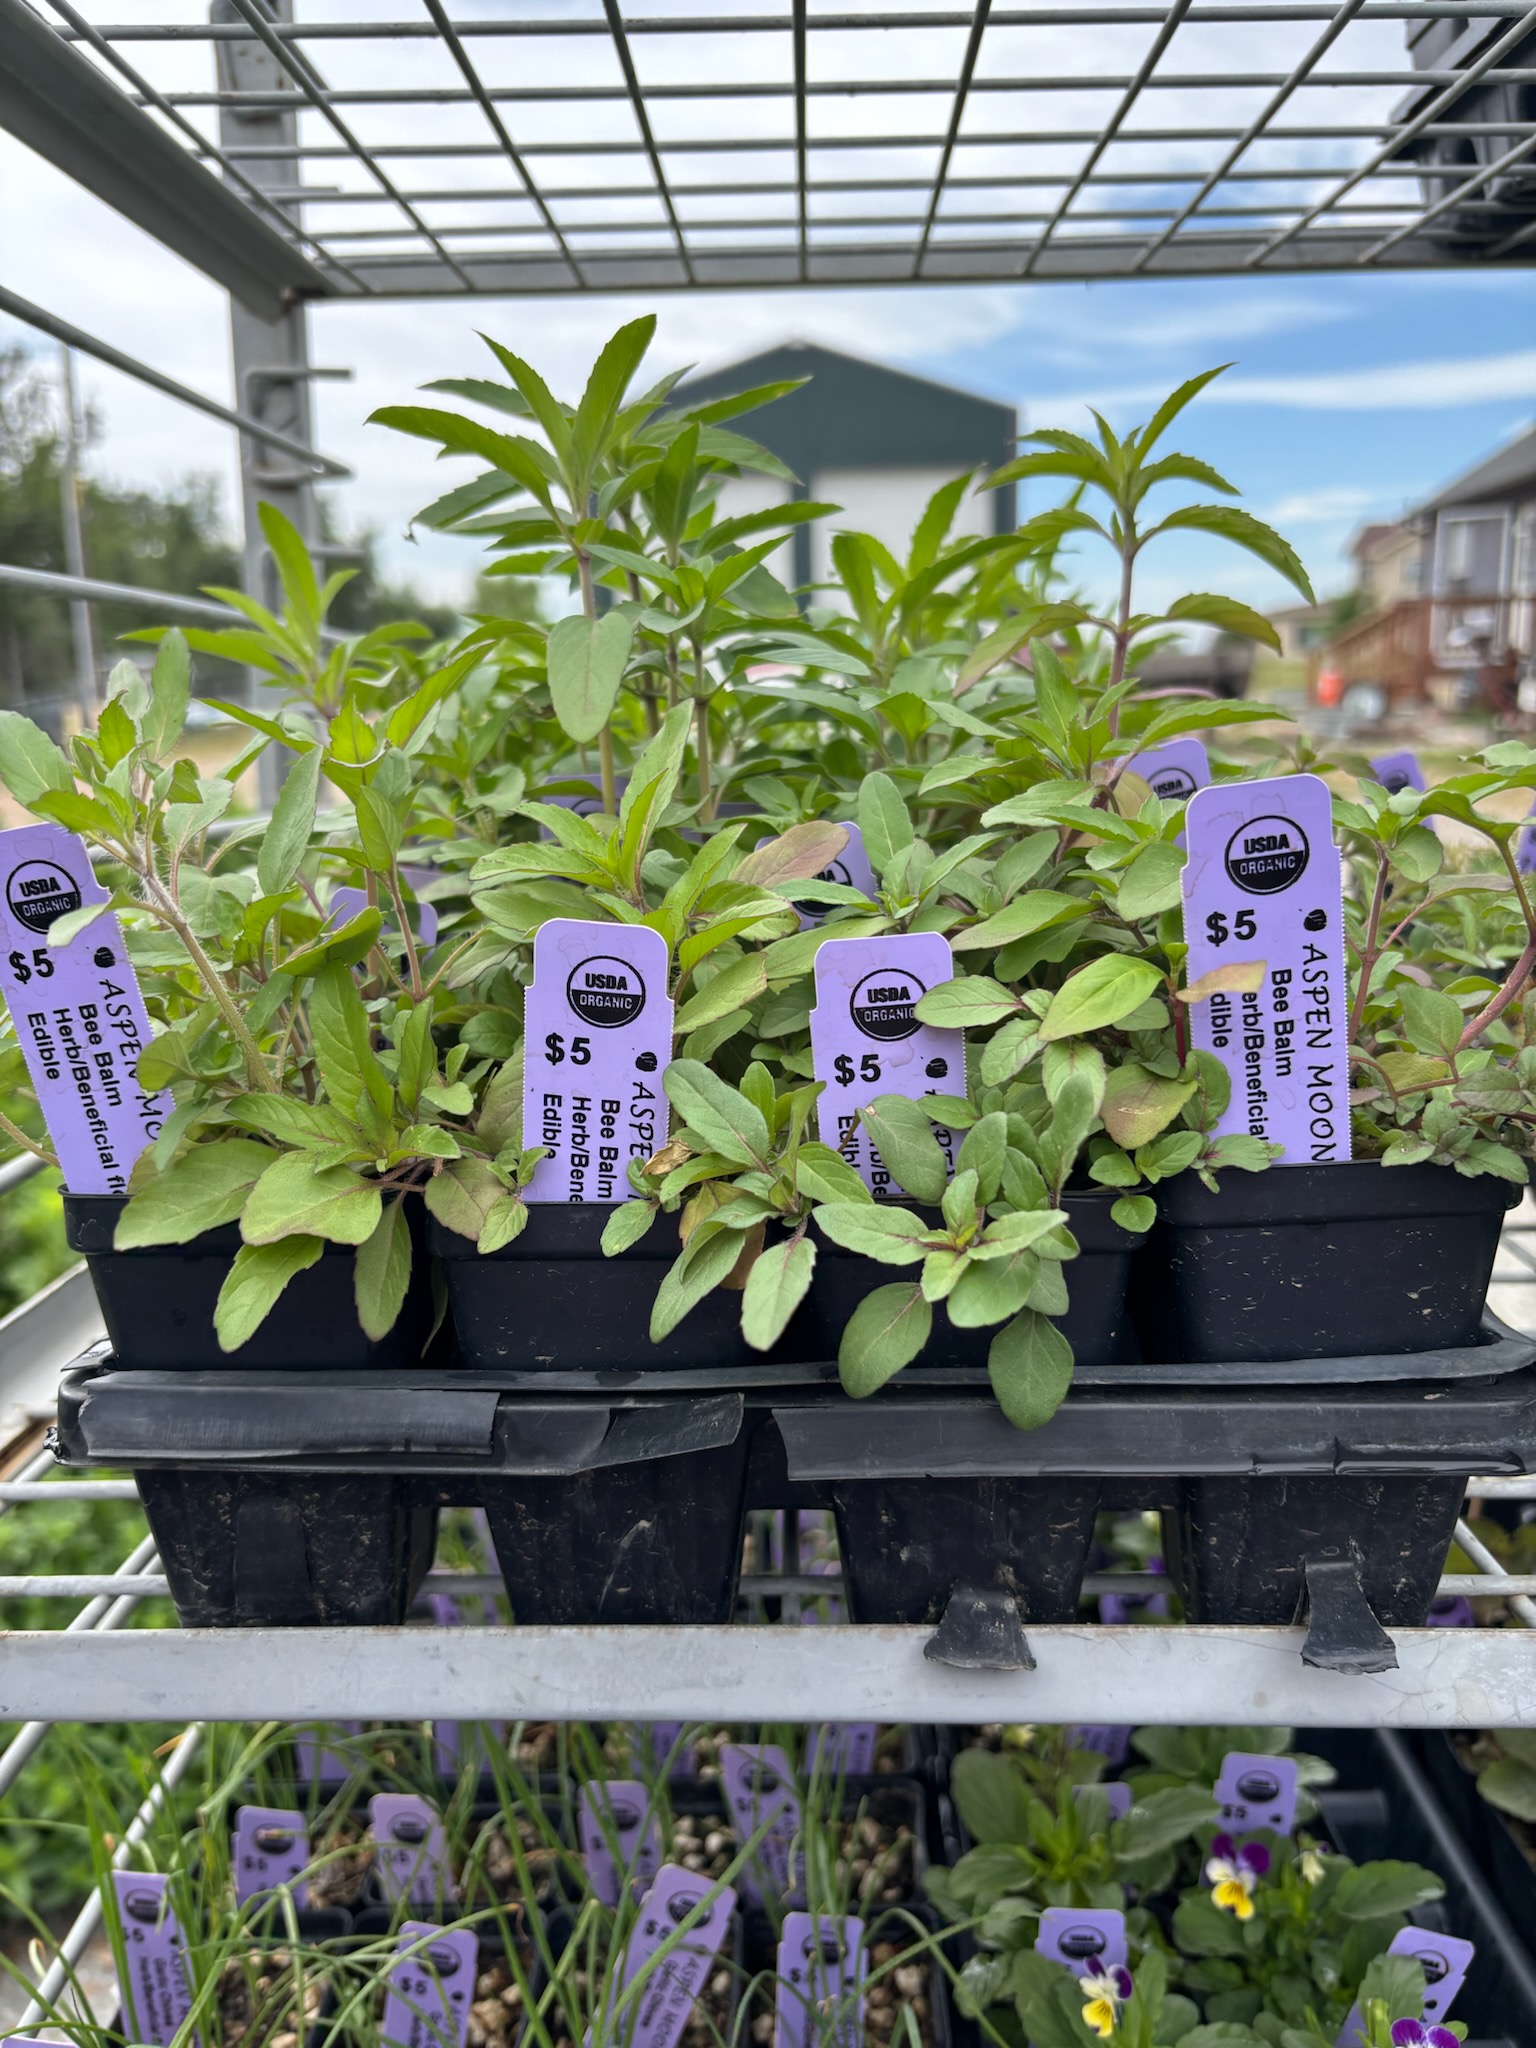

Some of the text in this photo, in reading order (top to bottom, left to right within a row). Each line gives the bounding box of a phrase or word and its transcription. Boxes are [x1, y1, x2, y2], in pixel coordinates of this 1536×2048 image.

[1243, 833, 1290, 855] USDA
[1239, 855, 1296, 876] ORGANIC
[19, 876, 62, 898] USDA
[22, 897, 72, 918] ORGANIC
[1206, 909, 1257, 948] $5
[8, 948, 55, 985] $5
[585, 973, 628, 991] USDA
[579, 993, 633, 1010] ORGANIC
[867, 986, 911, 1004] USDA
[1209, 993, 1232, 1048] dible
[1271, 968, 1296, 1077] Bee Balm
[27, 1011, 60, 1080] Edible
[79, 1003, 123, 1107] Bee Balm
[545, 1032, 592, 1066] $5
[1302, 943, 1337, 1162] ASPEN MOON
[834, 1054, 881, 1087] $5
[1241, 992, 1269, 1141] erb/Beneficial
[53, 1007, 121, 1170] Herb/Beneficial
[628, 1081, 656, 1160] ASPE
[597, 1099, 621, 1199] Bee Balm
[838, 1116, 861, 1168] Edibl
